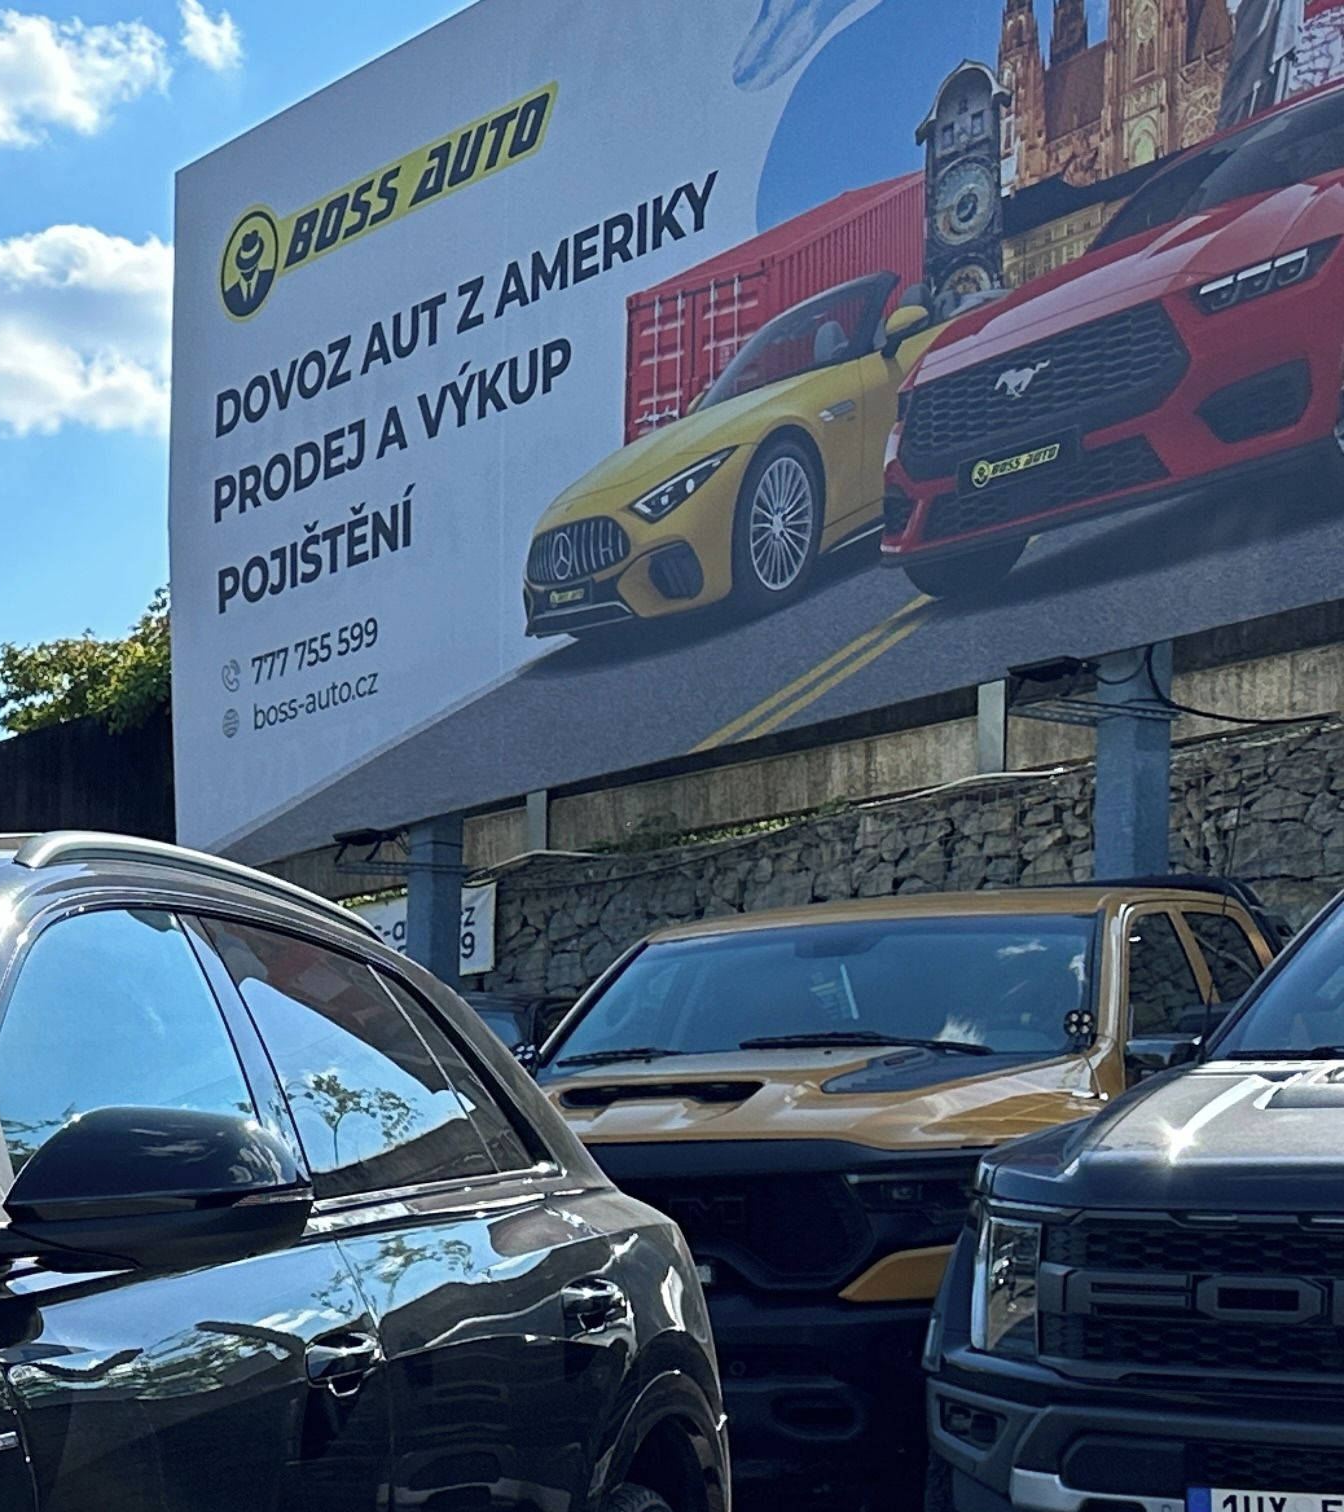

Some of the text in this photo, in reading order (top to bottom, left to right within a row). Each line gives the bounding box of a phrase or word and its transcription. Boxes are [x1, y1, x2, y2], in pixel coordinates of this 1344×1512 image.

[283, 90, 550, 270] BOSS AUTO
[215, 170, 719, 438] DOVOZ AUT Z AMERIKY
[214, 337, 572, 523] PRODEJ A VÝKUP
[217, 484, 417, 614] POJIŠTĚNÍ
[251, 617, 378, 685] 777 755 599
[253, 672, 379, 731] boss-auto.cz
